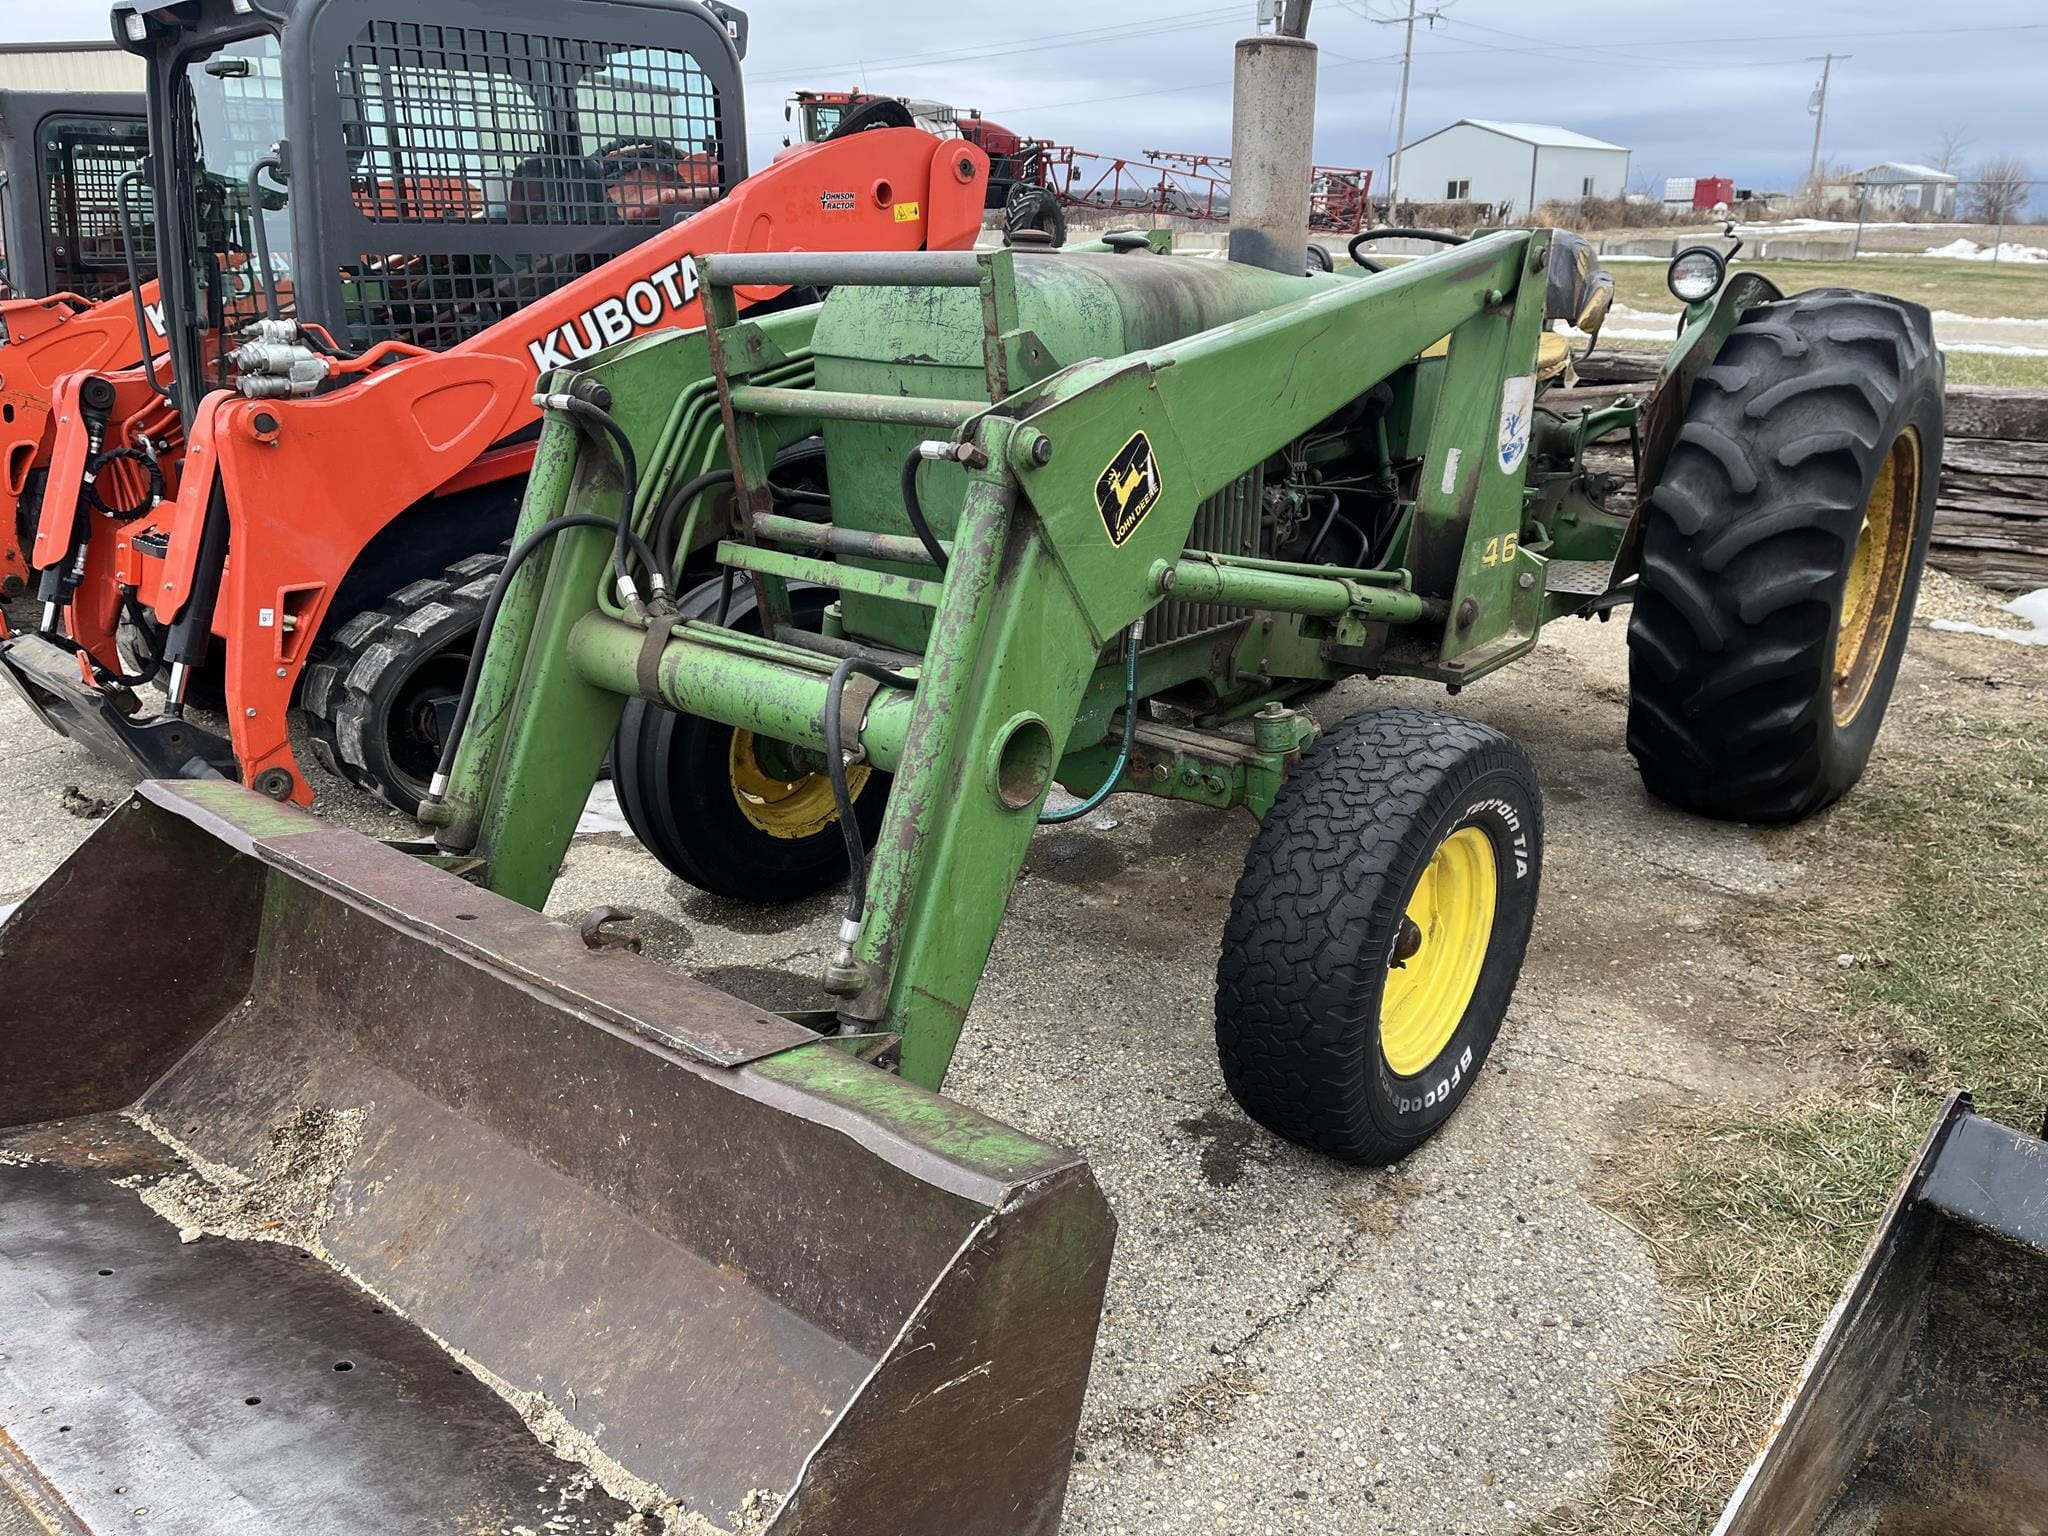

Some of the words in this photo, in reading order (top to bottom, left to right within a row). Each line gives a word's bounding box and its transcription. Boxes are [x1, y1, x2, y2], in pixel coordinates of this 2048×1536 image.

[820, 191, 855, 201] JOHNSON
[821, 200, 855, 210] TRACTOR
[527, 254, 700, 374] KUBOTA
[1116, 513, 1136, 541] JOHN
[1135, 482, 1159, 515] DEERE
[1481, 532, 1518, 568] 46
[1513, 832, 1528, 880] T/A
